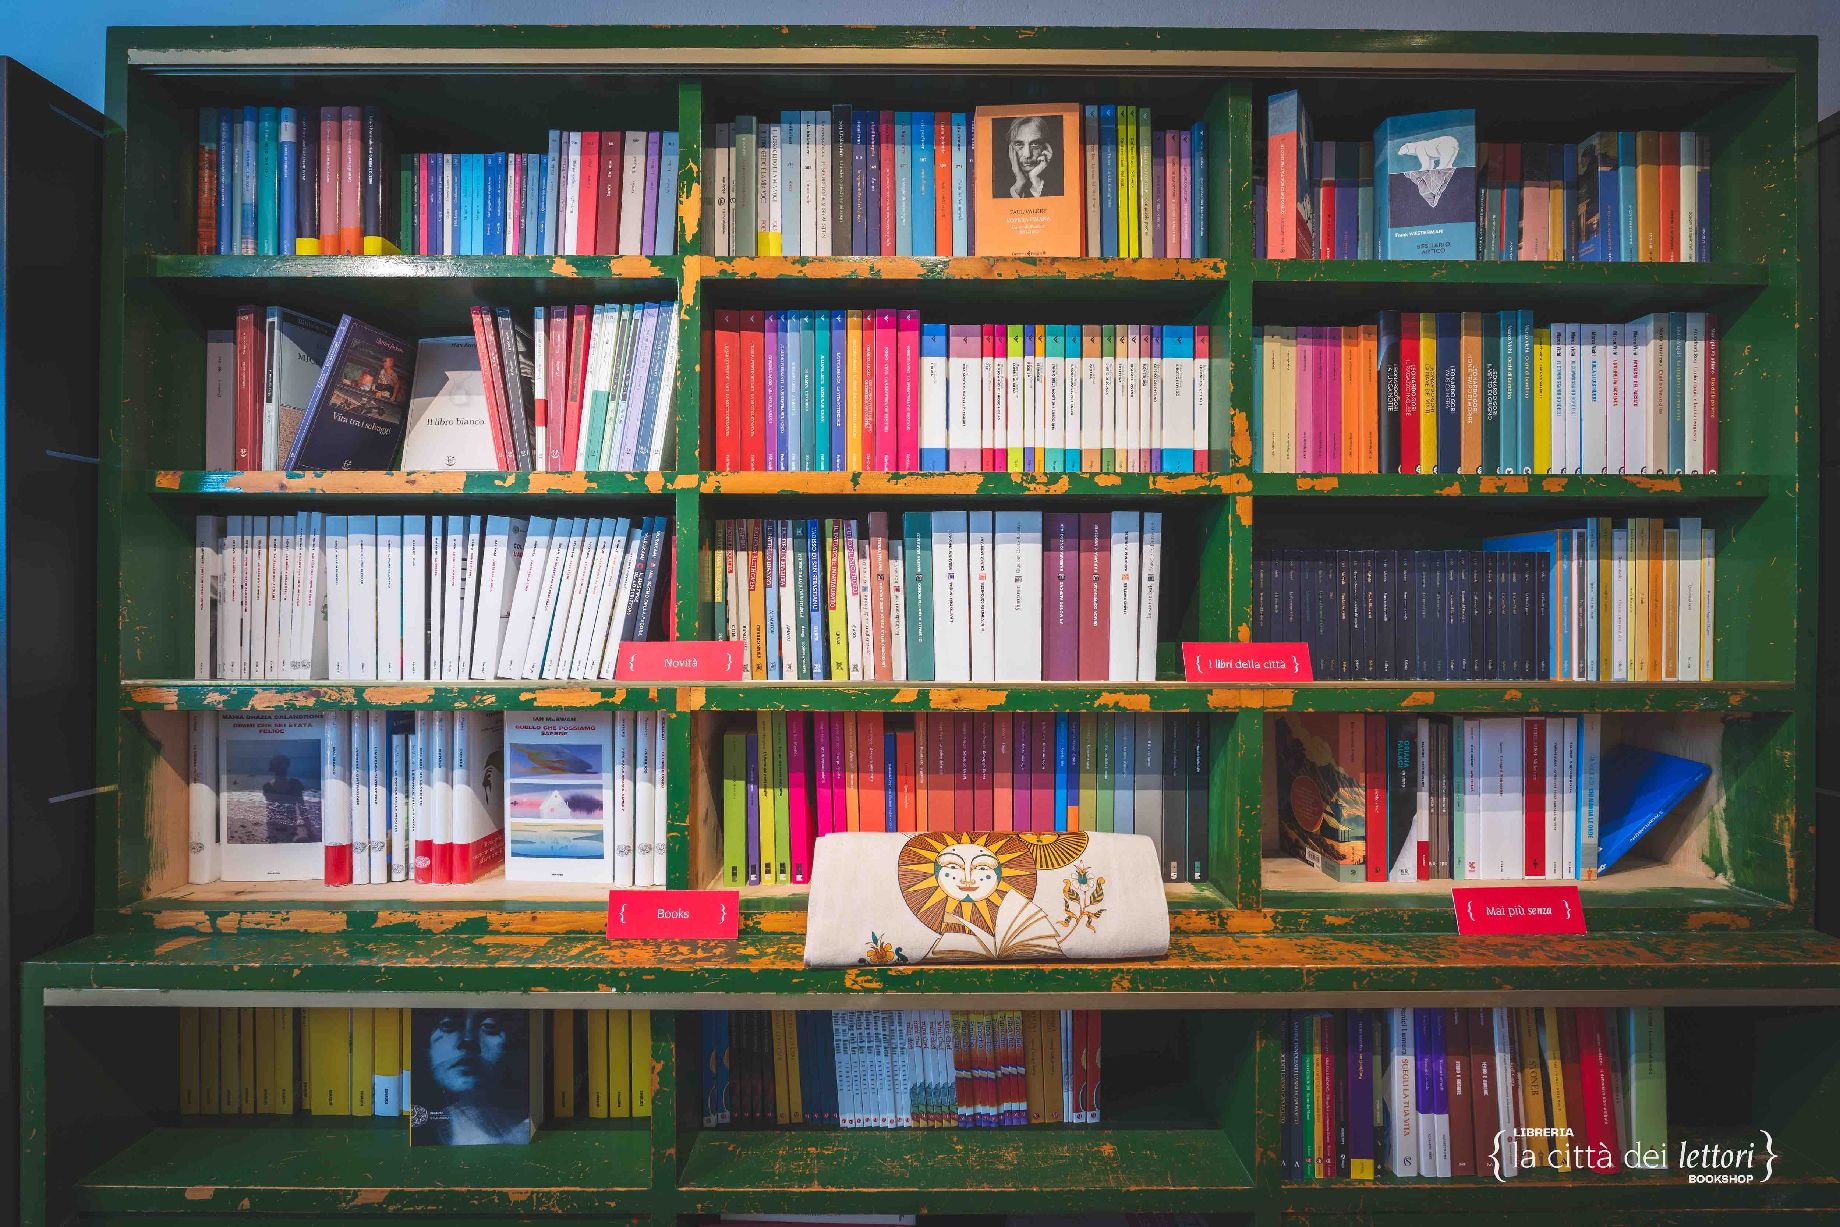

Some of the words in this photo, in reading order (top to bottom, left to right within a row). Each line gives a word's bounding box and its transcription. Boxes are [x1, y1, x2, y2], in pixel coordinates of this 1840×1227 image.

[434, 417, 454, 426] libro
[456, 417, 485, 426] bianco
[664, 657, 698, 668] Novità
[1208, 659, 1212, 669] I
[1215, 658, 1232, 669] libri
[1234, 658, 1260, 669] della
[1263, 659, 1286, 669] città
[657, 907, 690, 919] Books
[1485, 905, 1505, 916] Mai
[1507, 904, 1524, 918] più
[1527, 907, 1552, 915] senza
[1401, 1058, 1409, 1086] SCEGLI
[1403, 1088, 1409, 1098] LA
